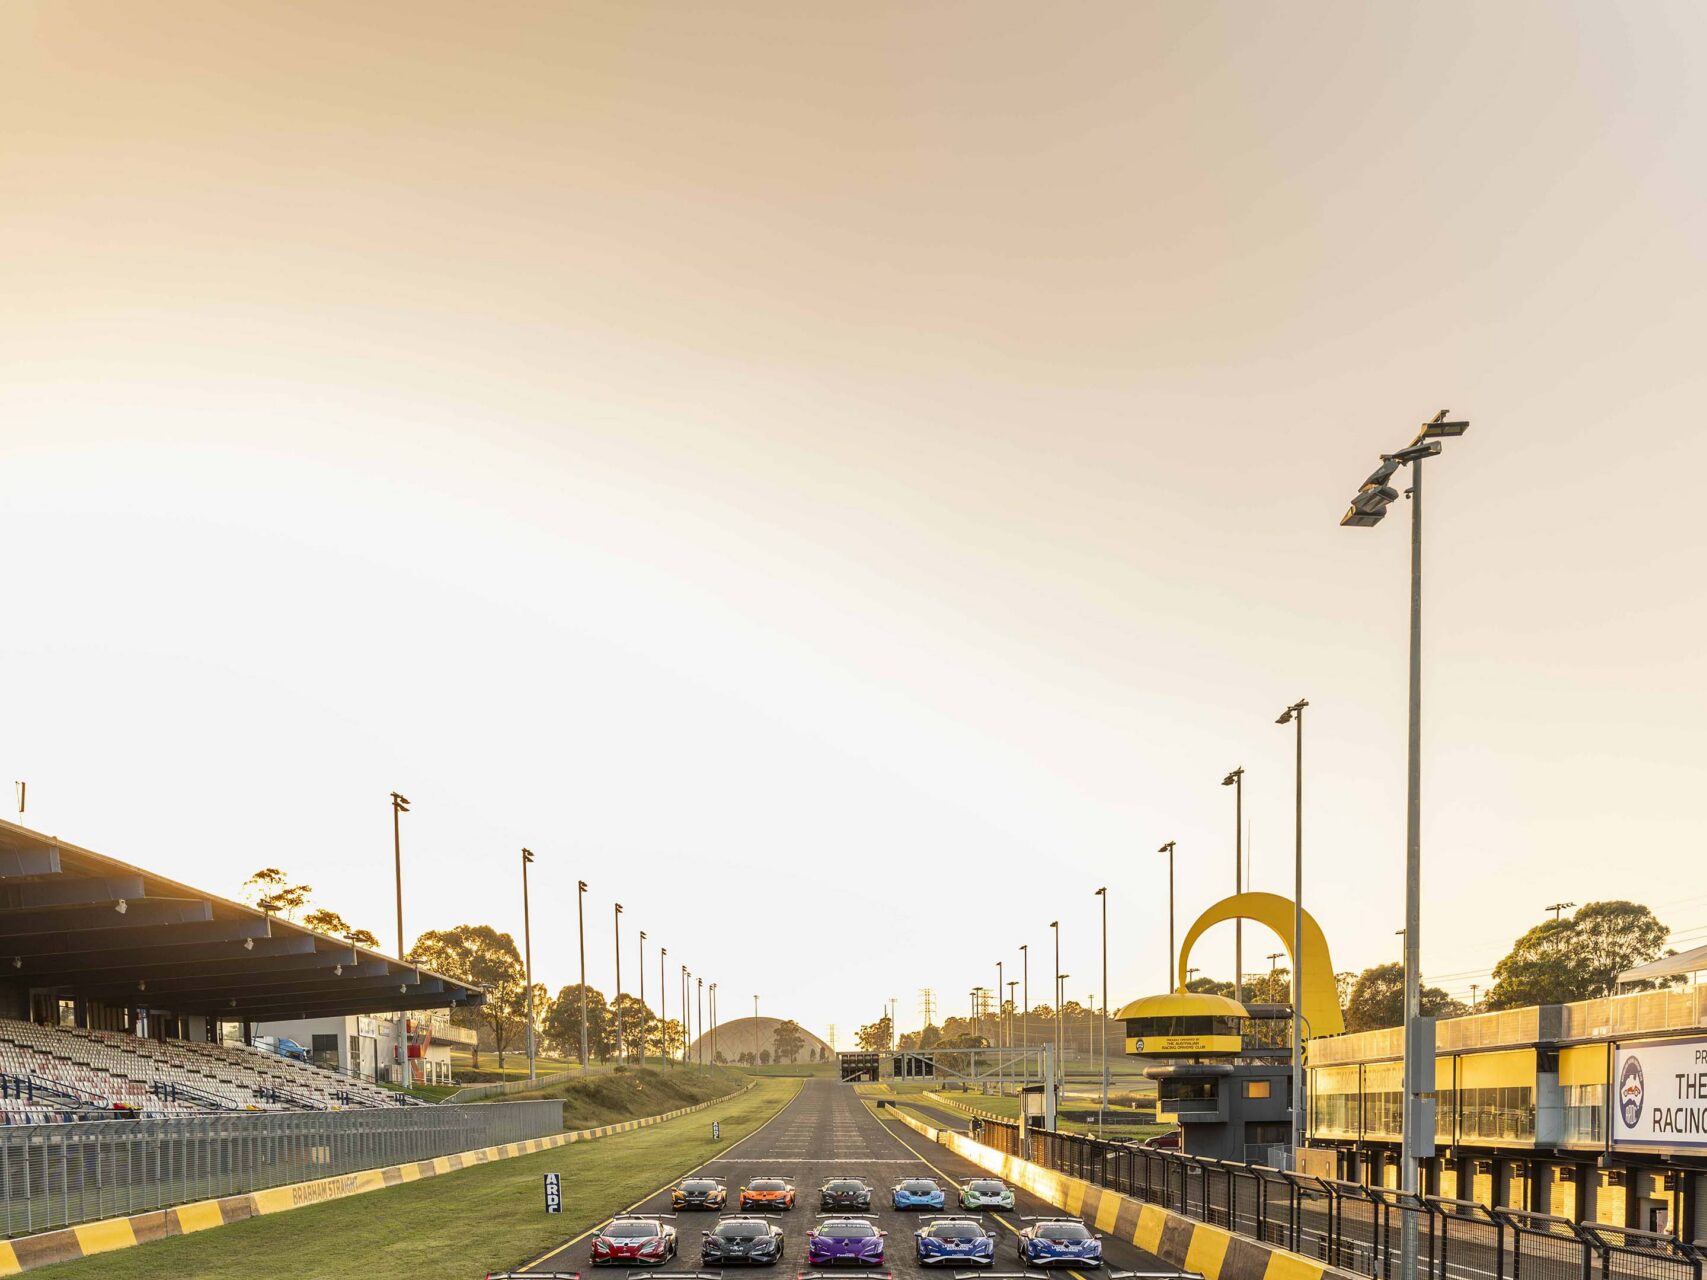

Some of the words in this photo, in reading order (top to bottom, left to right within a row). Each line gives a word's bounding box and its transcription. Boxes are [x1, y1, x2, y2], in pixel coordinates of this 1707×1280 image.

[1675, 1073, 1707, 1100] THE
[292, 1181, 328, 1206] BRABHAM
[546, 1173, 559, 1213] ARDC
